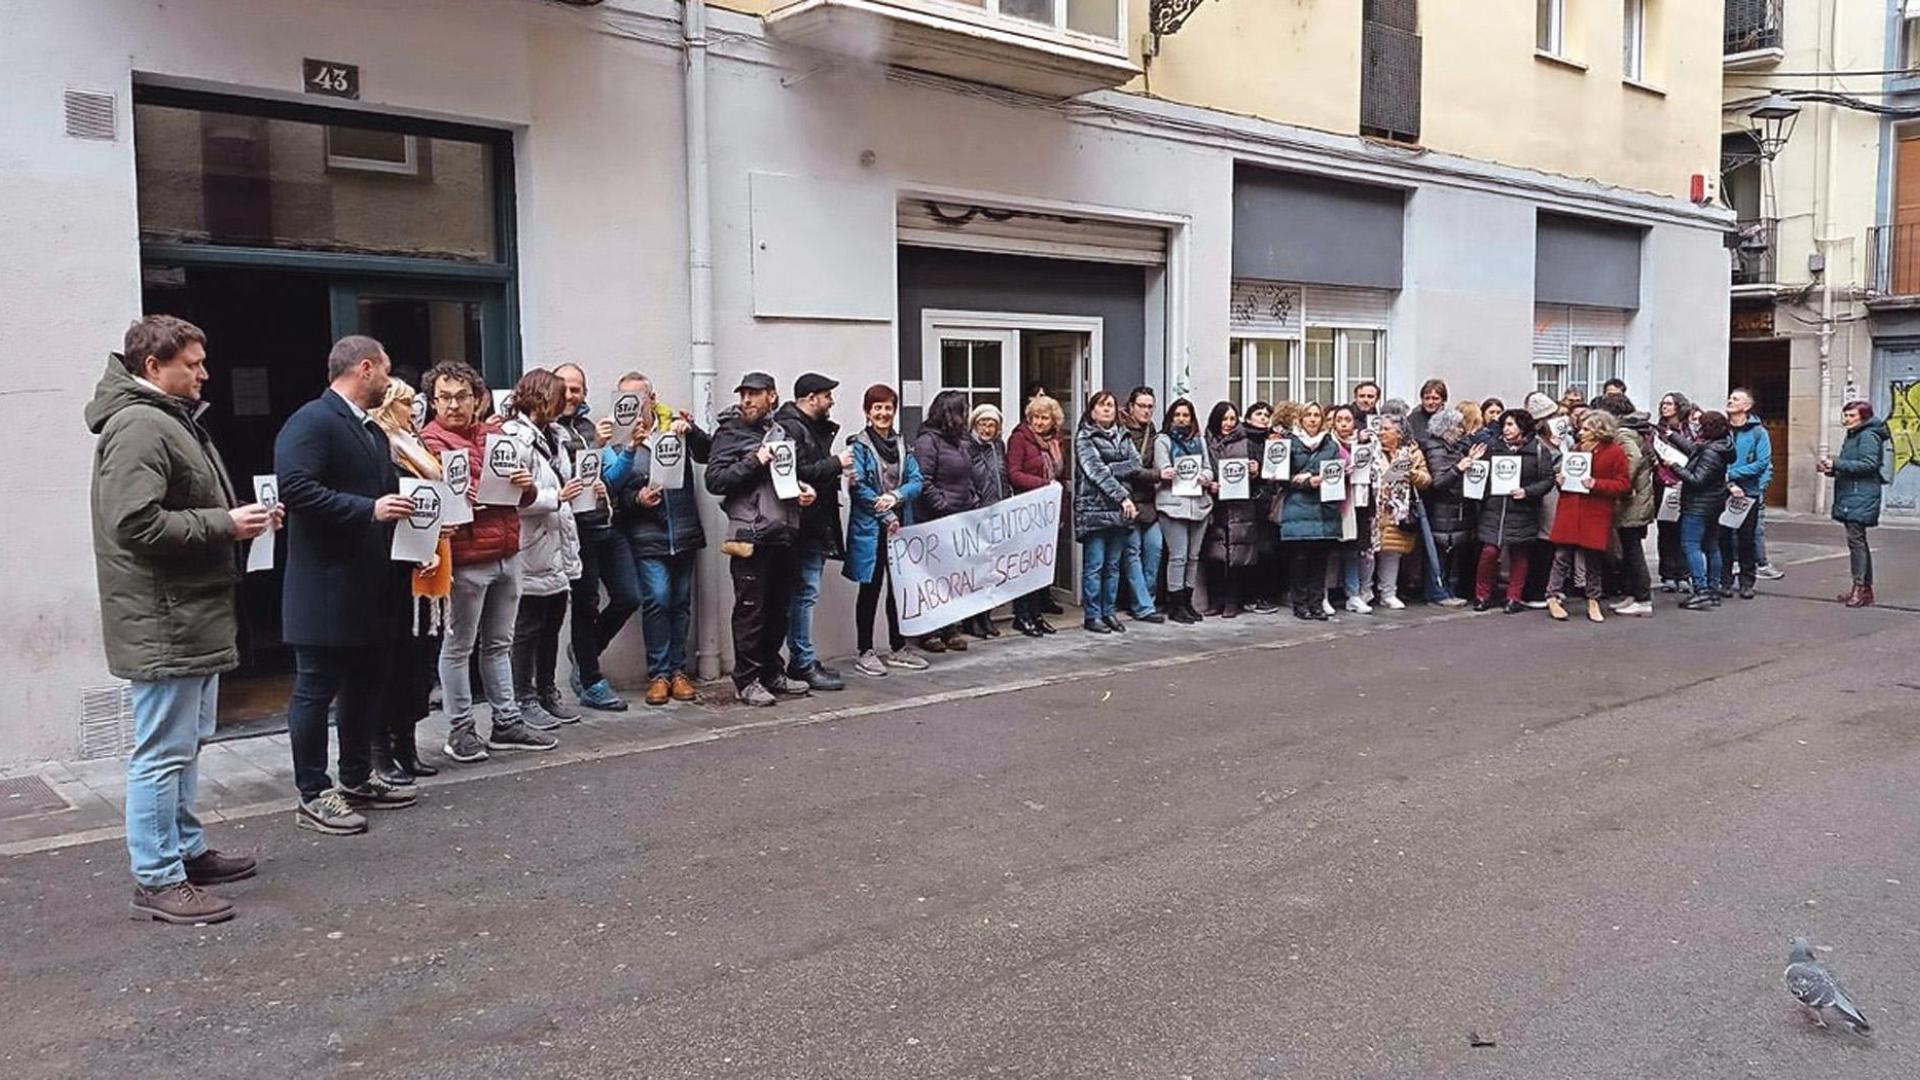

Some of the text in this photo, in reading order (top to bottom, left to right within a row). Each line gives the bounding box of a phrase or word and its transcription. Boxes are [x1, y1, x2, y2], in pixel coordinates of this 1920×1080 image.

[311, 66, 348, 91] 43
[617, 403, 638, 412] STOP
[494, 450, 517, 461] STOP
[659, 443, 681, 453] STOP
[893, 501, 1056, 575] POR UN ENTORNO
[903, 543, 1054, 620] LABORAL SEGURO
